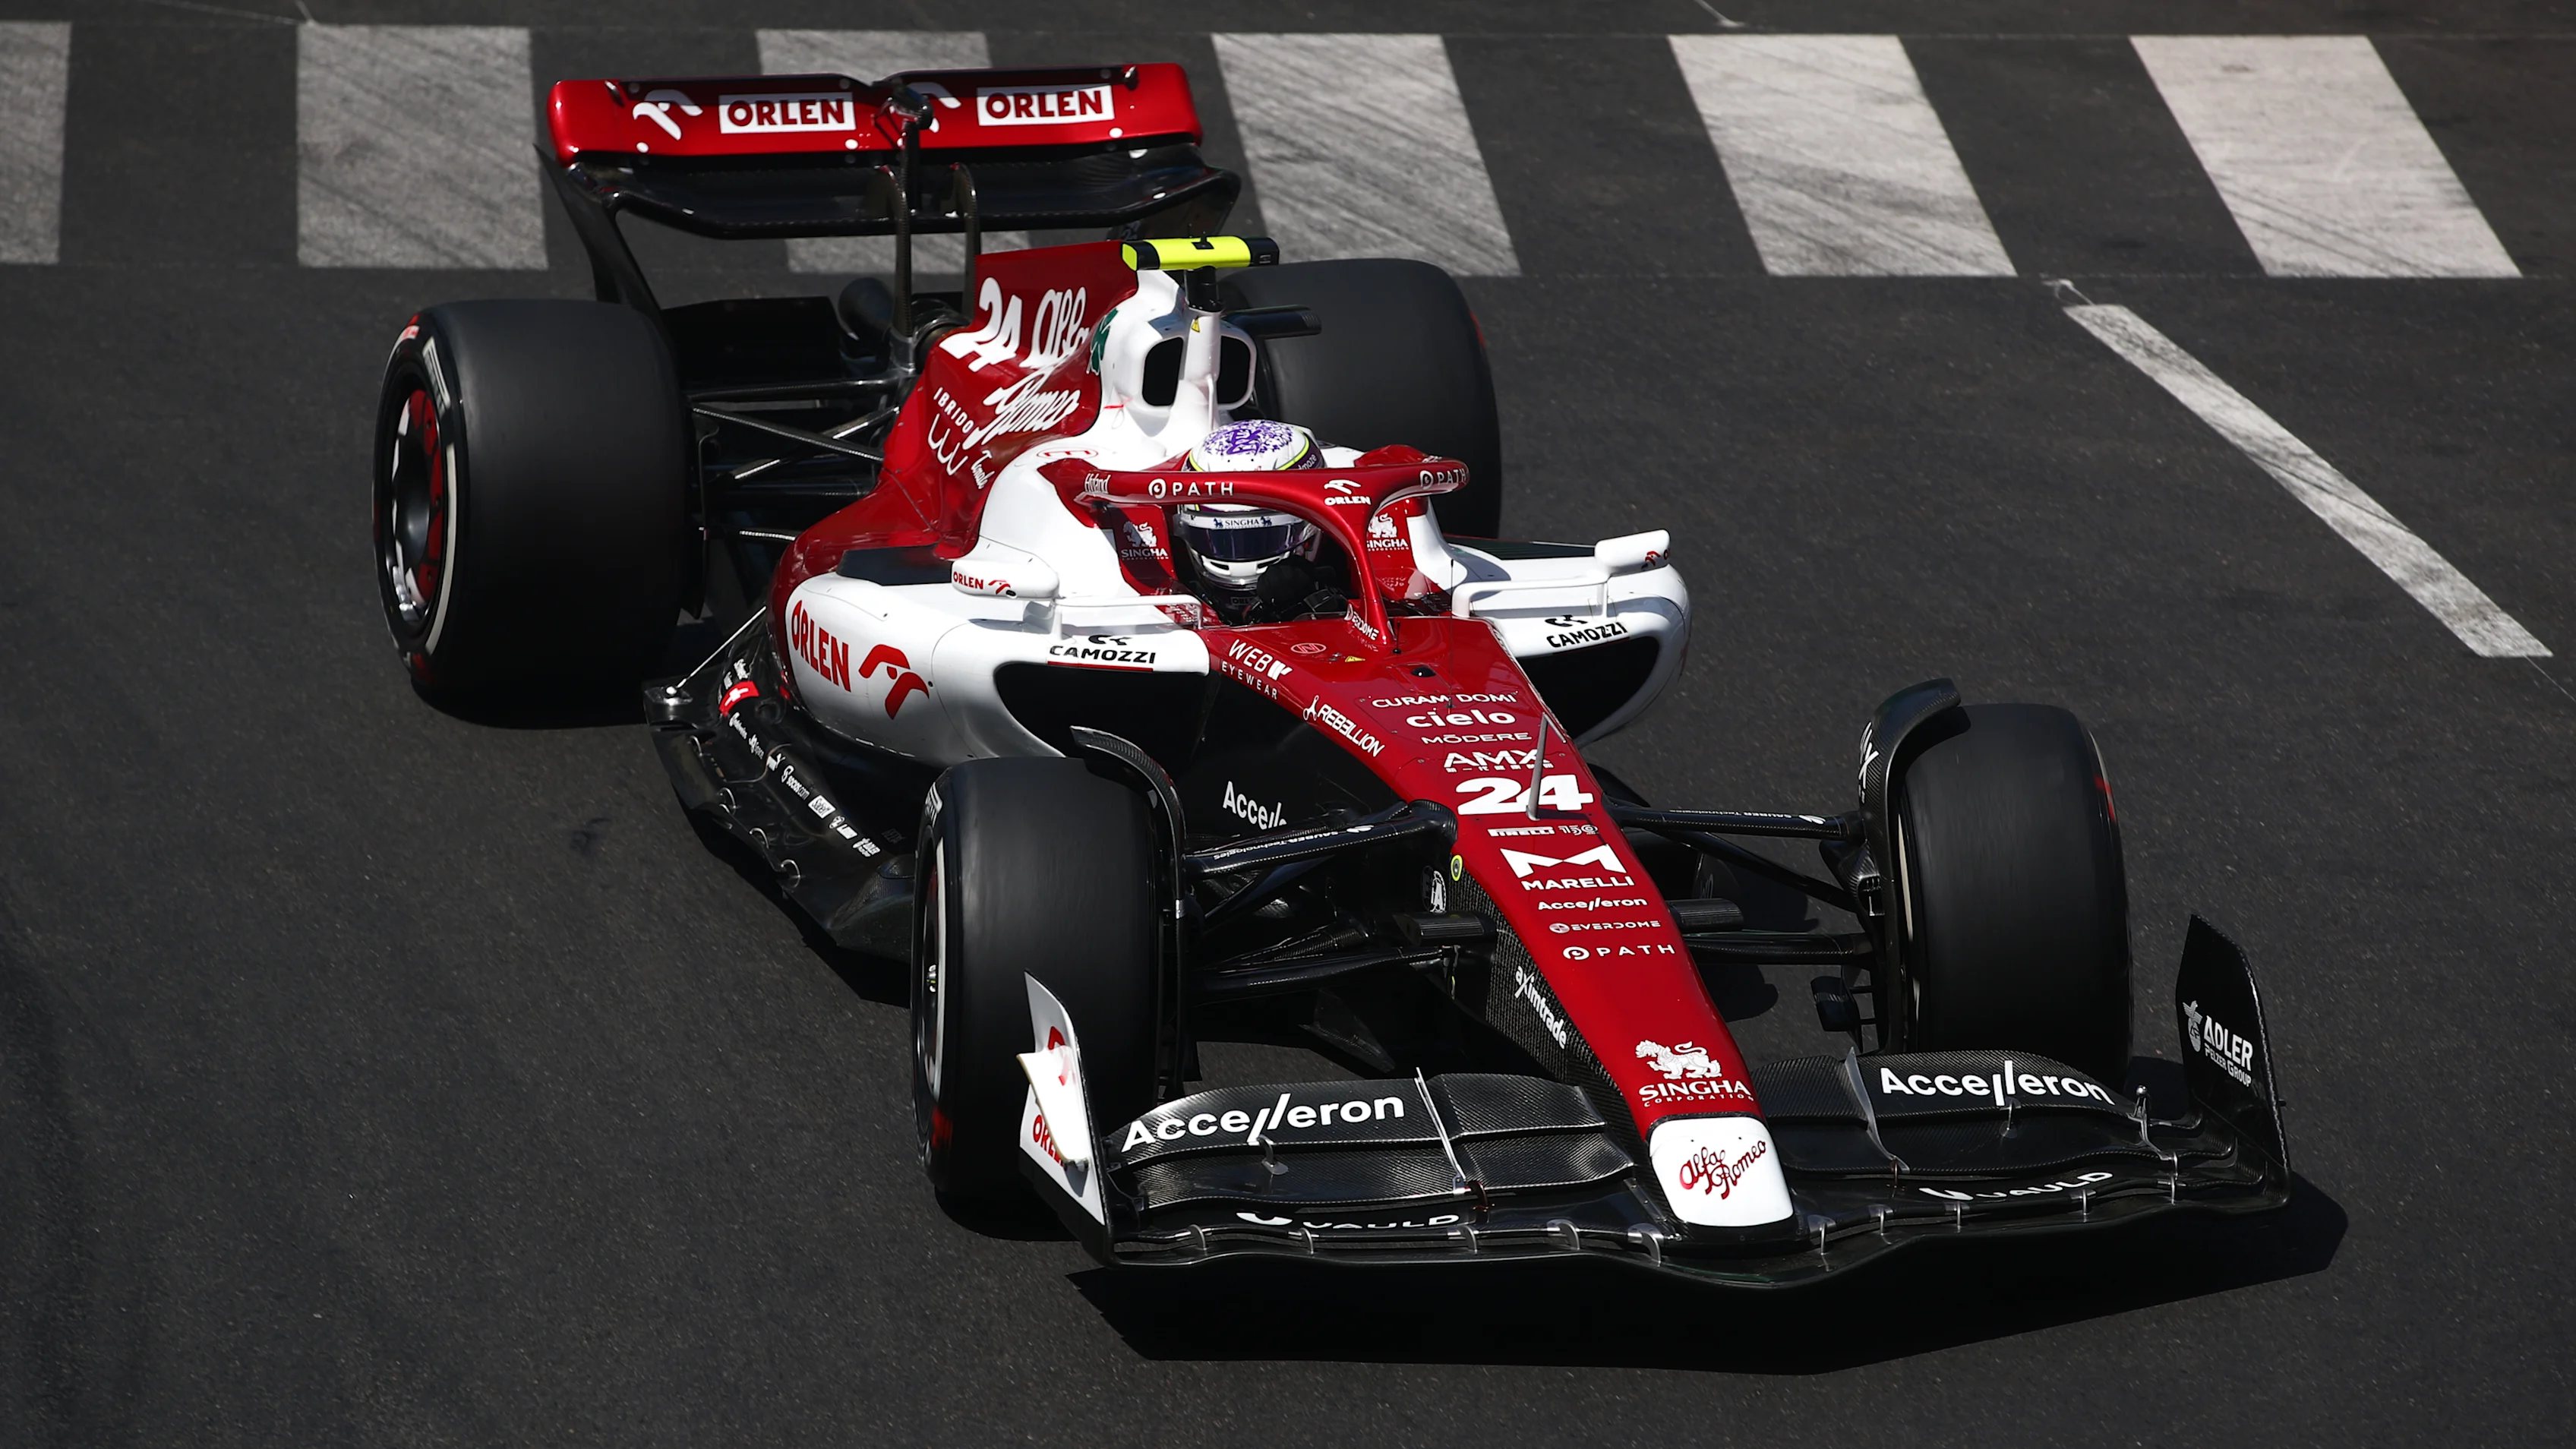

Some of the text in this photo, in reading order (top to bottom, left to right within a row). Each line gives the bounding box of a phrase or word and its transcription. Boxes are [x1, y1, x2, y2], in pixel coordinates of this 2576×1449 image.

[728, 99, 845, 128] ORLEN
[984, 90, 1106, 120] ORLEN
[939, 277, 1022, 372] 24
[933, 387, 974, 434] IBRIDO
[962, 367, 1081, 450] Romeo
[1172, 481, 1234, 497] PATH
[1437, 468, 1466, 486] PATH
[1324, 496, 1372, 506] ORLEN
[1121, 548, 1169, 559] SINGHA
[952, 571, 984, 590] ORLEN
[791, 600, 851, 693] ORLEN
[1546, 622, 1628, 648] CAMOZZI
[1050, 646, 1157, 665] CAMOZZI
[1229, 639, 1274, 672] WEB
[1221, 661, 1277, 700] EYEWEAR
[1372, 693, 1518, 708] CURAM DOMI
[1406, 709, 1516, 728] cielo
[1444, 749, 1550, 768] AMX
[1223, 781, 1287, 830] Accell
[1456, 774, 1594, 815] 24
[1487, 826, 1555, 837] PIRELLI
[1520, 876, 1635, 891] MARELLI
[1571, 920, 1662, 931] EVERDOME
[1596, 945, 1676, 957] PATH
[2204, 1015, 2254, 1072] ADLER
[2204, 1043, 2252, 1088] PELZER GROUP
[1639, 1080, 1752, 1102] SINGHA
[1644, 1094, 1754, 1107] CORPORATION
[1033, 1114, 1067, 1171] ORL
[1679, 1146, 1726, 1190] Alfa
[1705, 1140, 1766, 1200] Romeo
[1976, 1172, 2113, 1198] VAULD
[1302, 1214, 1460, 1229] VAULD
